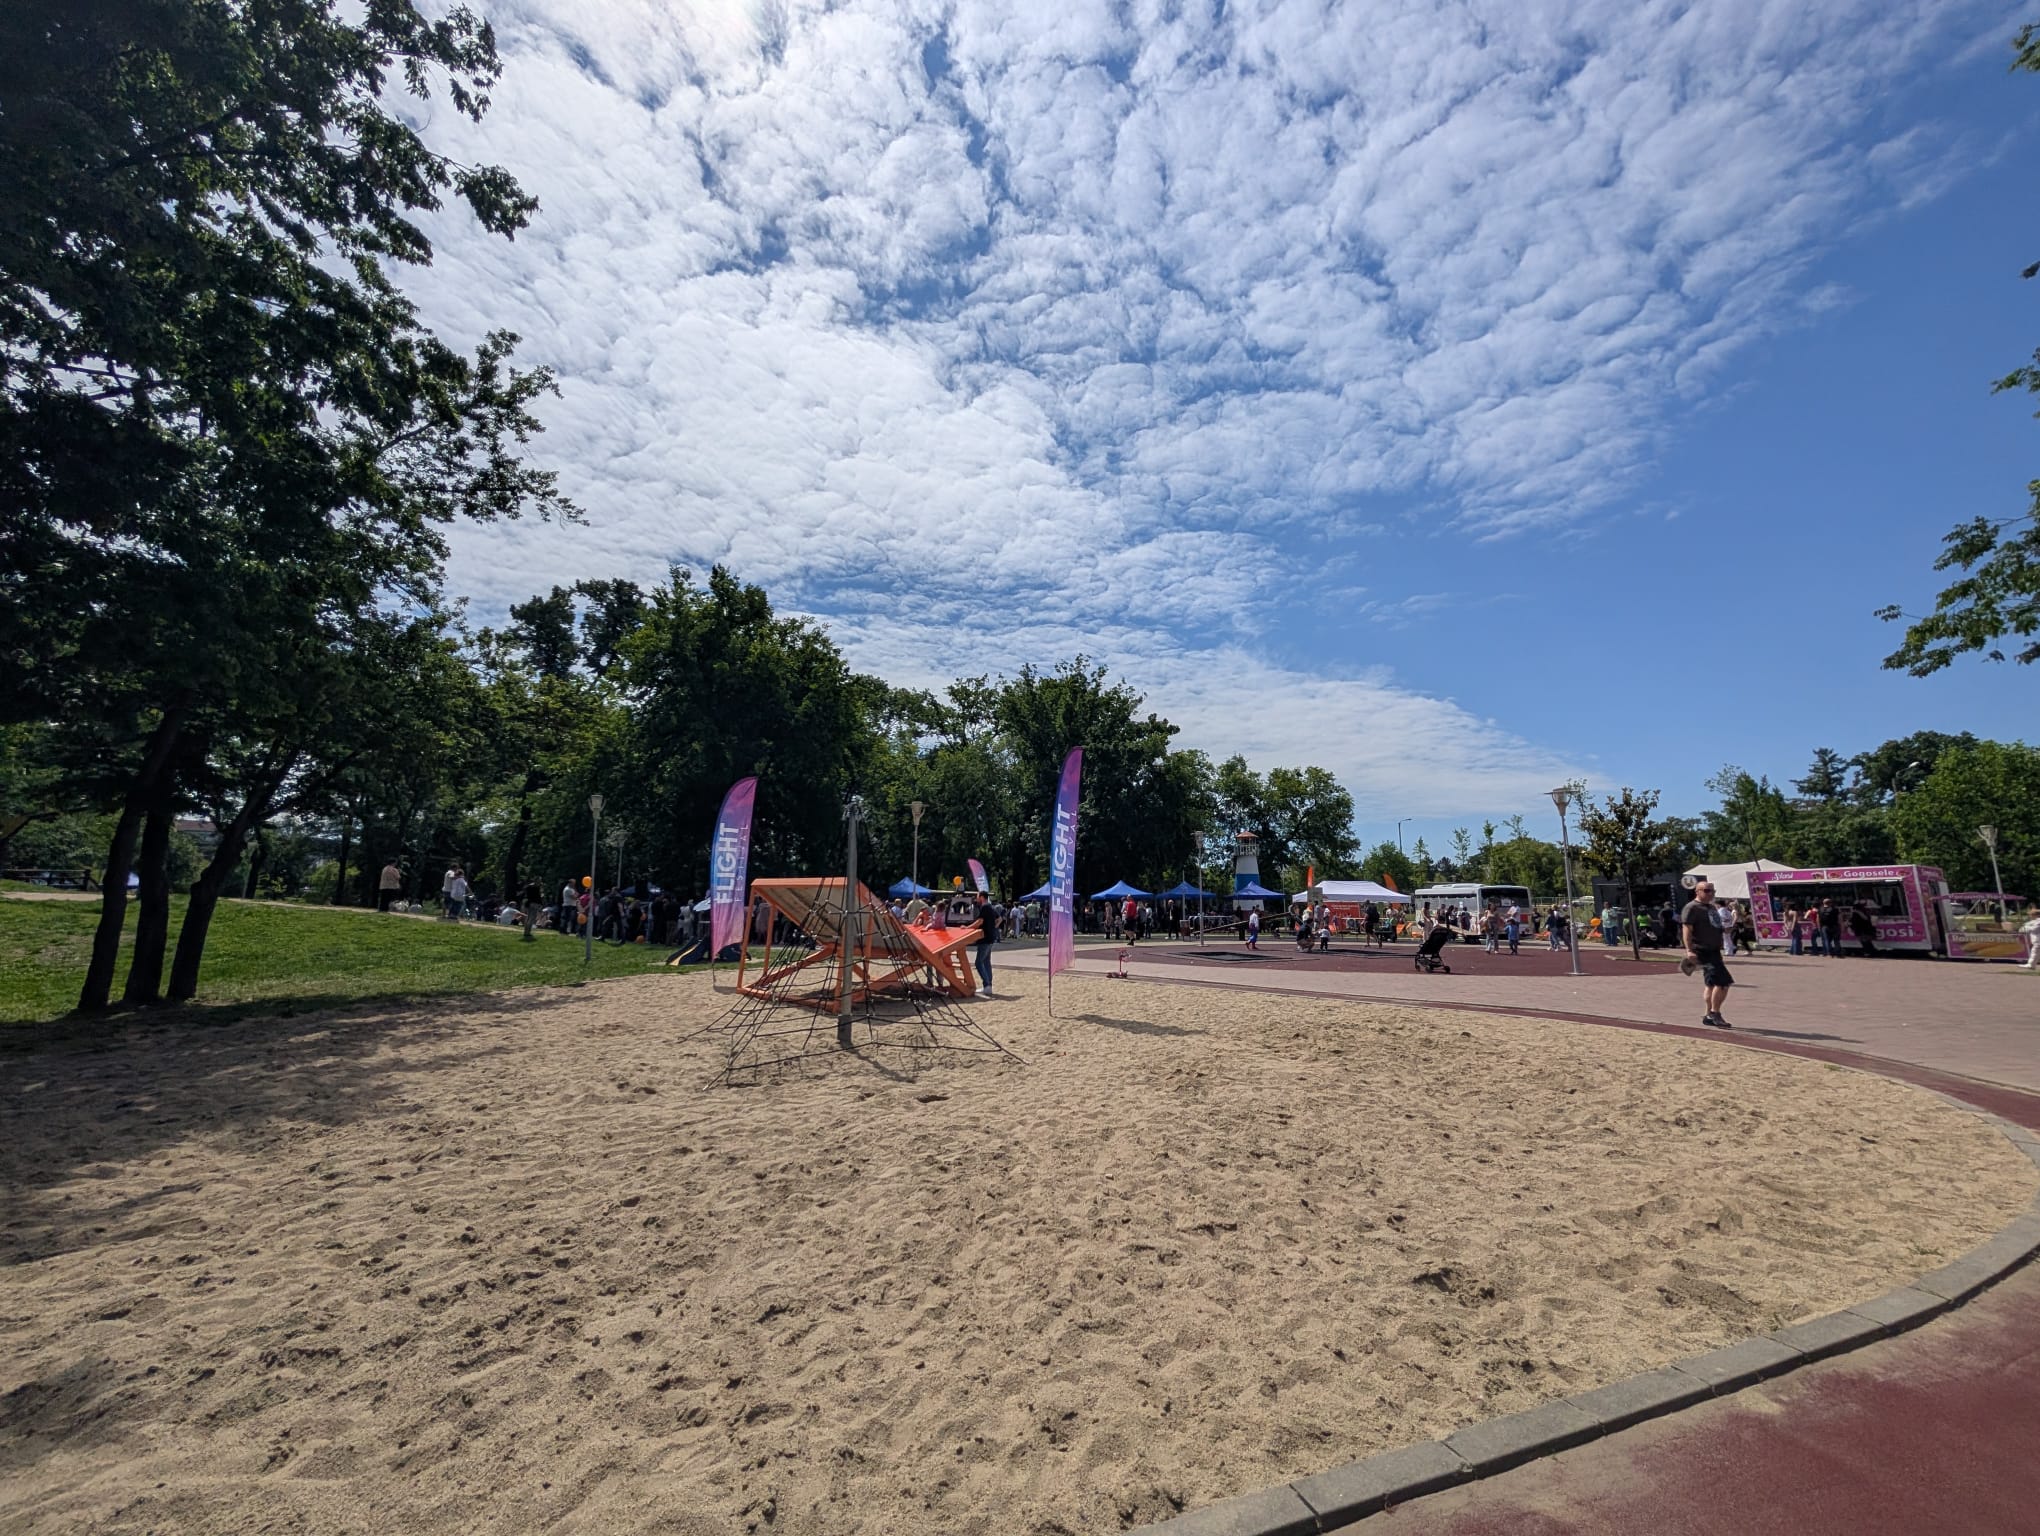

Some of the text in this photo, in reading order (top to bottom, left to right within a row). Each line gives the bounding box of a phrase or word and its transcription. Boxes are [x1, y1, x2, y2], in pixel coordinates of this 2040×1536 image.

[716, 823, 739, 904] FLIGHT
[1051, 803, 1071, 912] FLIGHT
[1843, 869, 1895, 880] Gogosele
